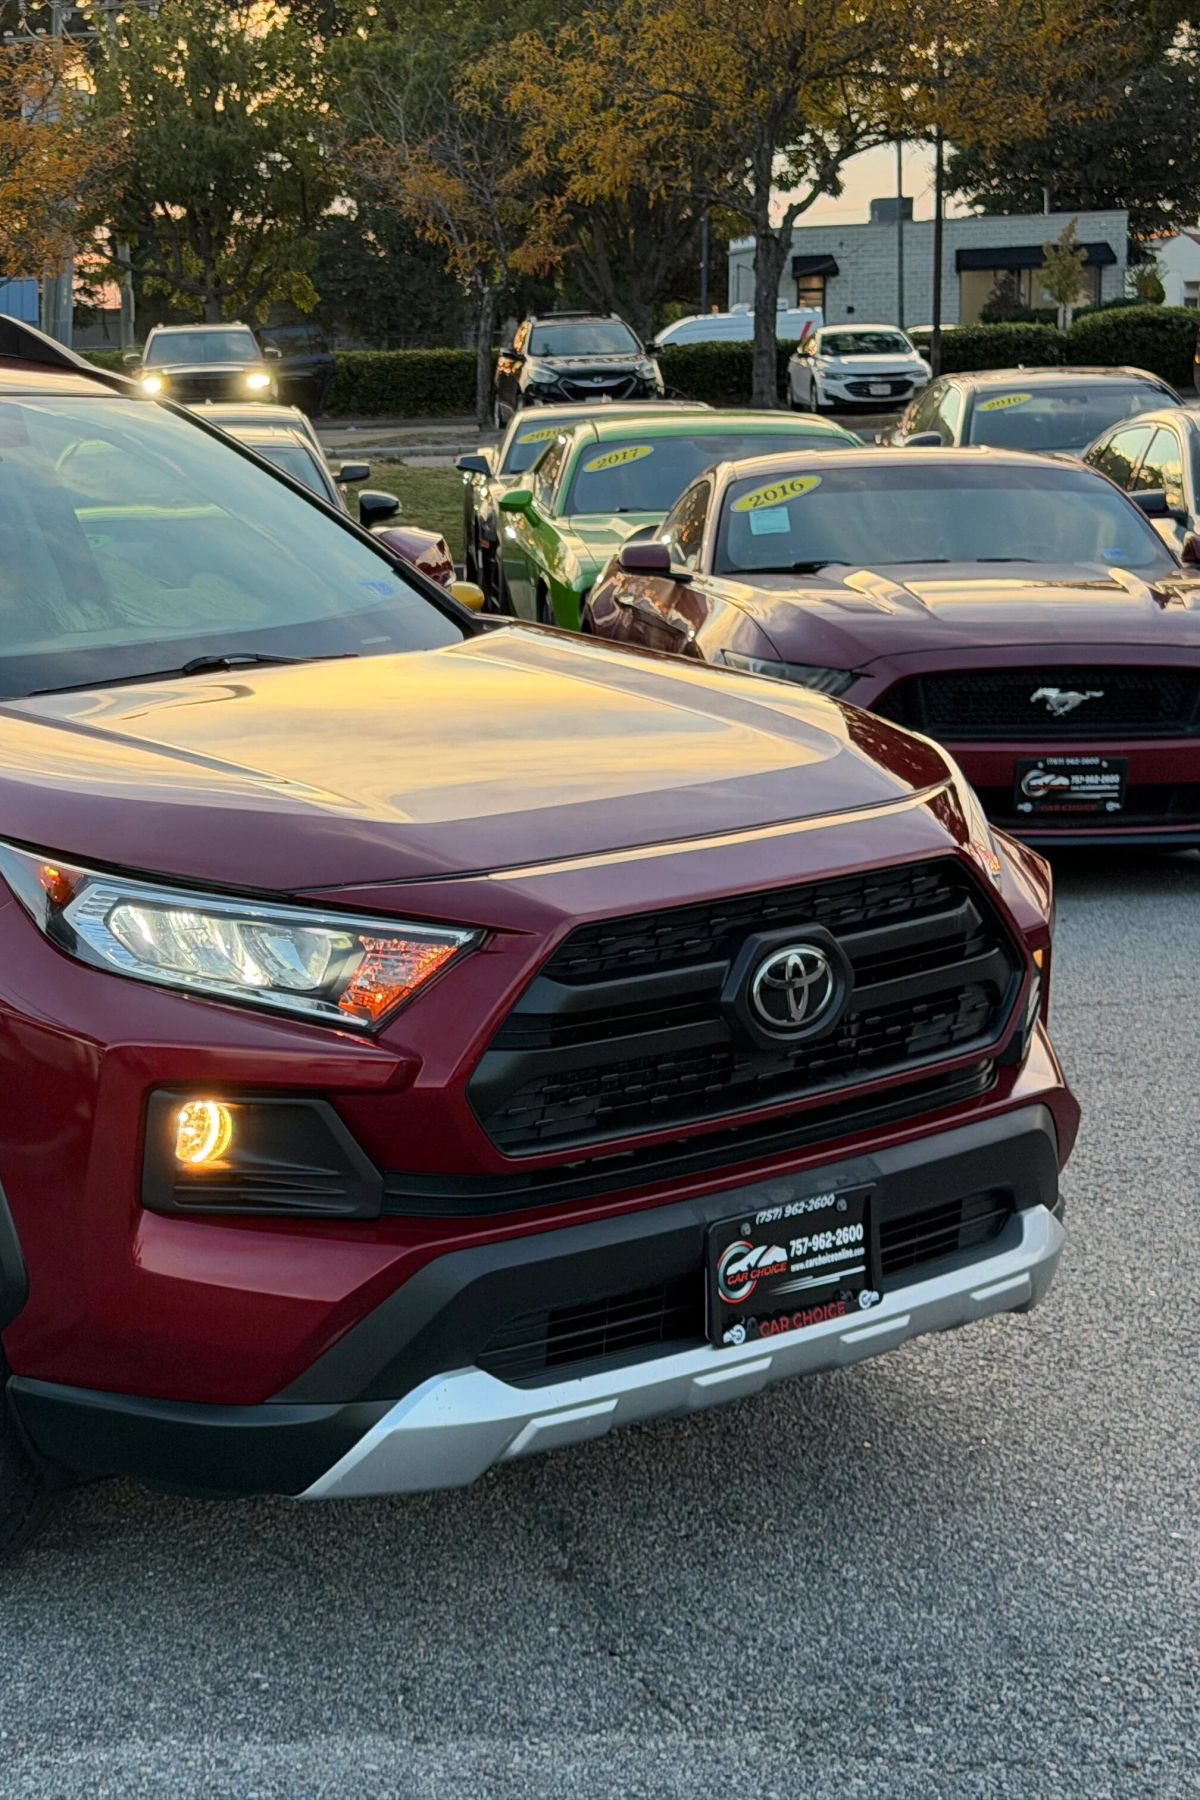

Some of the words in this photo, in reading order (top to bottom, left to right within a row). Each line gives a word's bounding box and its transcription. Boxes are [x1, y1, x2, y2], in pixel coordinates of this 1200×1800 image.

[597, 448, 640, 468] 2017
[749, 480, 805, 508] 2016
[755, 1207, 782, 1225] (757)
[784, 1193, 836, 1218] 962-2600
[789, 1223, 864, 1258] 757-962-2600
[727, 1271, 749, 1286] CAR
[750, 1262, 788, 1280] CHOICE
[759, 1315, 791, 1337] CAR
[792, 1301, 846, 1329] CHOICE
